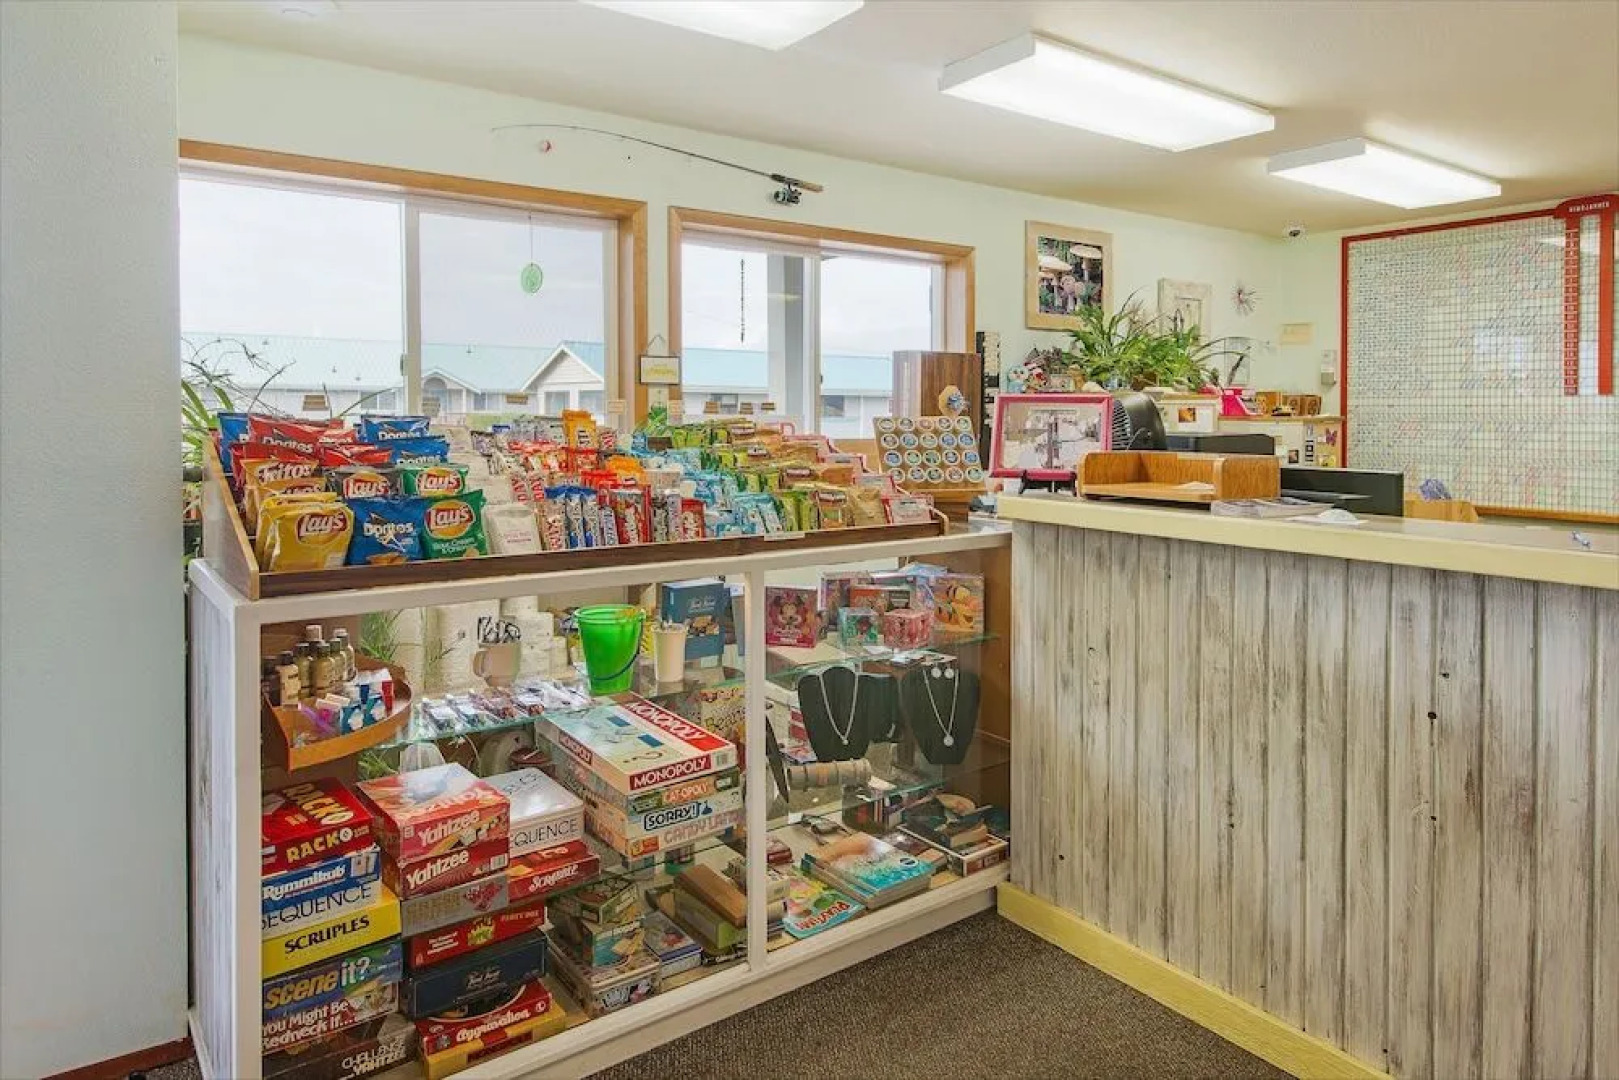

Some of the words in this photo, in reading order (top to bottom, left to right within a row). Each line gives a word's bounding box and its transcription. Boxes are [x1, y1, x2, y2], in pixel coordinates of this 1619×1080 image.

[263, 436, 314, 454] Doritos
[257, 461, 312, 485] Fritos
[299, 513, 346, 536] Lay's
[363, 522, 415, 537] Doritos
[429, 505, 471, 529] Lay's
[627, 702, 704, 739] MONOPOLY
[634, 757, 707, 788] MONOPOLY
[418, 811, 480, 847] Yahtzee
[648, 805, 697, 827] SORRY!
[406, 850, 469, 889] Yahtzee
[284, 914, 370, 954] SCRUPLES
[265, 969, 339, 1010] scene
[341, 956, 371, 986] it?
[289, 1005, 329, 1029] Might
[331, 999, 349, 1013] Be
